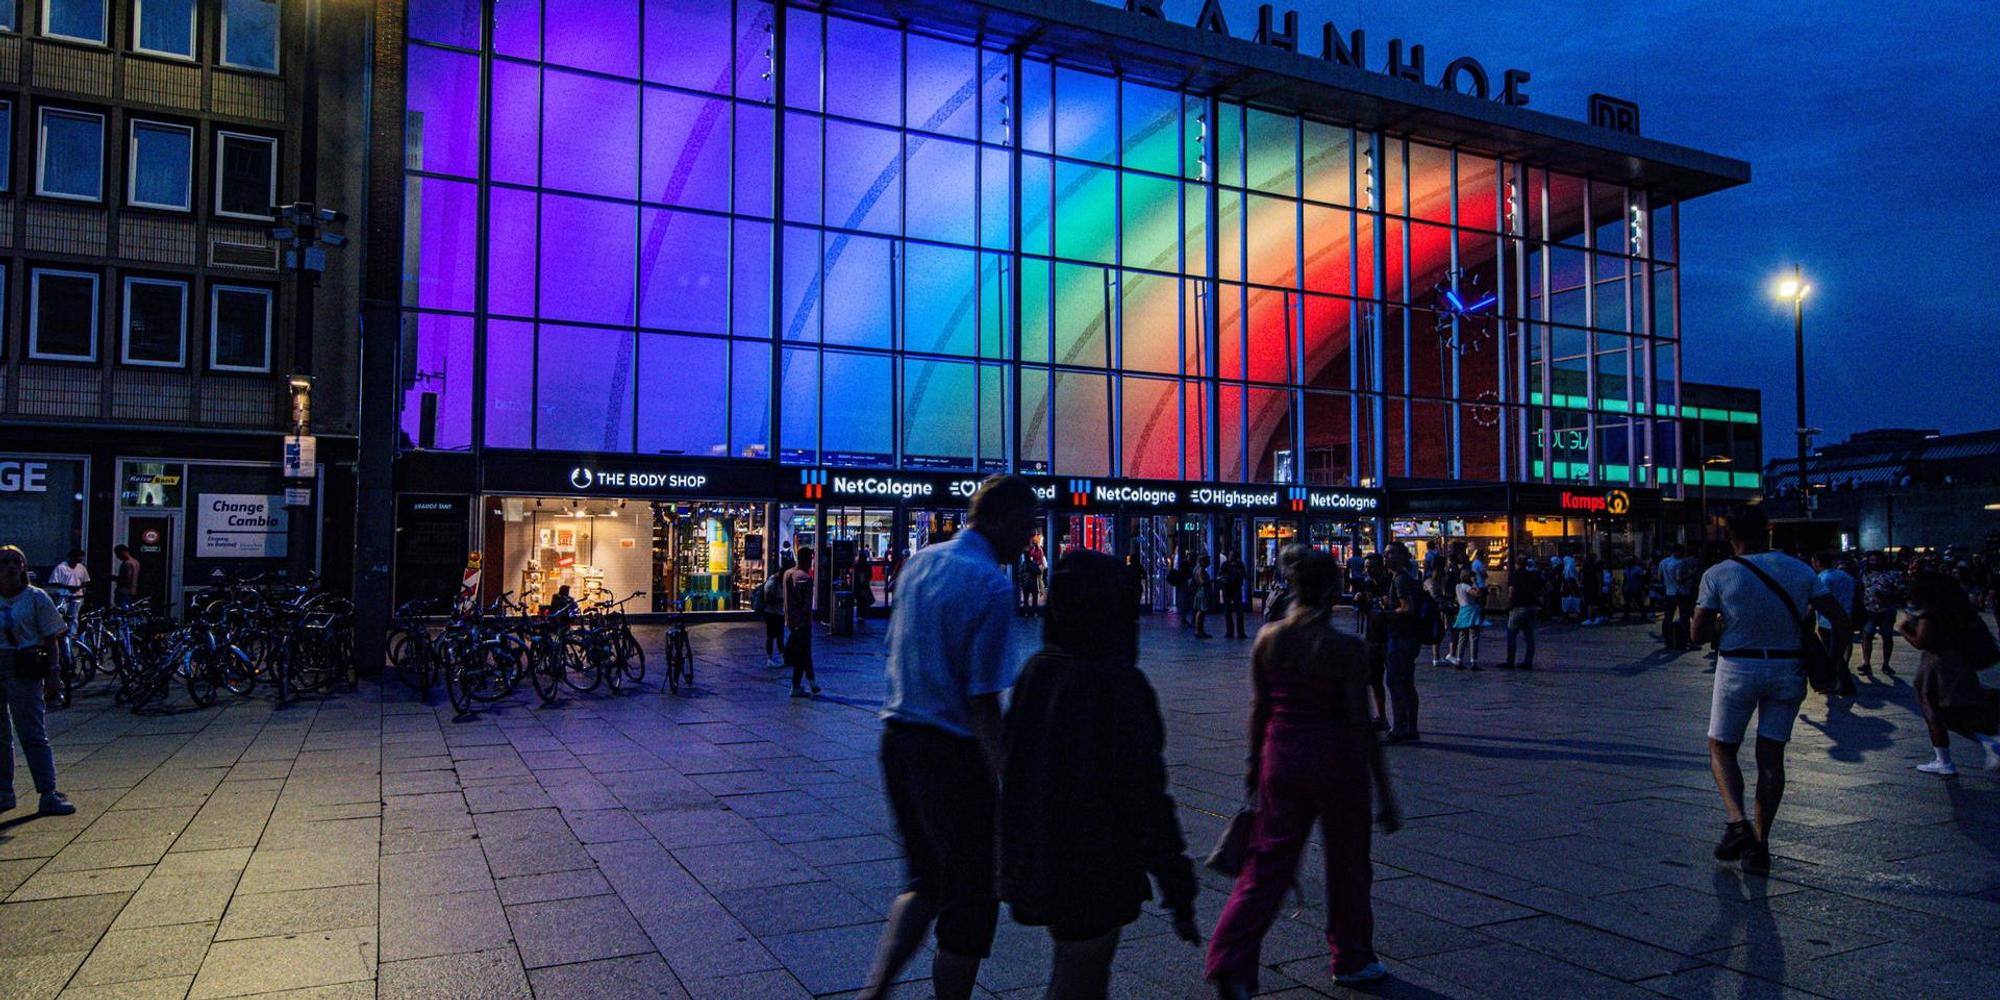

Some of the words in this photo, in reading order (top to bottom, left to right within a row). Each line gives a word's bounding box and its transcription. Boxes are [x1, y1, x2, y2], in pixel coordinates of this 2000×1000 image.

[0, 461, 48, 492] GE
[597, 472, 625, 487] THE
[629, 473, 667, 488] BODY
[668, 474, 706, 488] SHOP
[833, 477, 933, 497] NetCologne
[1096, 486, 1176, 507] NetCologne
[212, 499, 264, 516] Change
[1212, 489, 1277, 508] Highspeed
[1310, 493, 1377, 510] NetCologne
[1562, 492, 1605, 511] Kamps
[228, 514, 279, 528] Cambio
